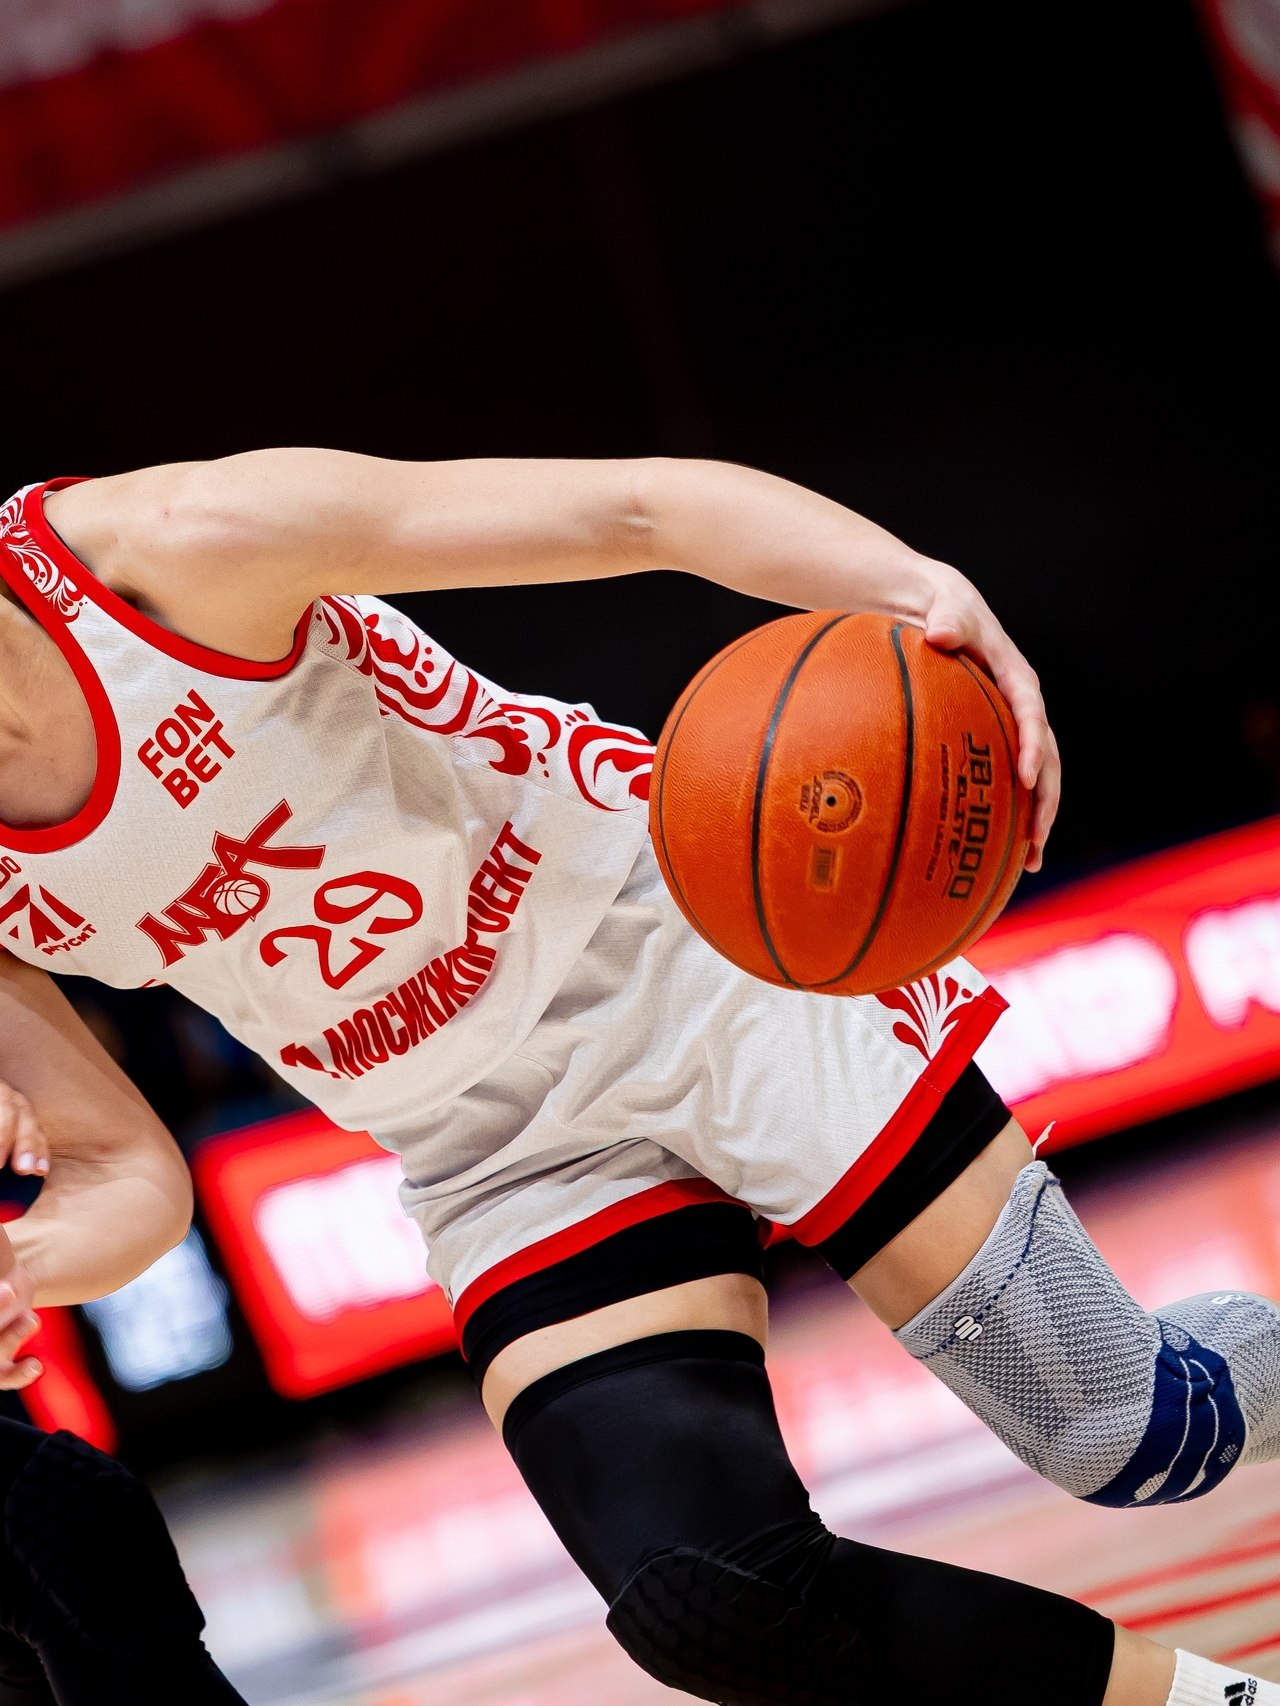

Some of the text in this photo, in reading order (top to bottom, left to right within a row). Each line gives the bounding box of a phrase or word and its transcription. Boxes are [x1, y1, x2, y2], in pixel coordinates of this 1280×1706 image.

[137, 688, 216, 779] FON
[161, 719, 236, 810] BET
[948, 733, 992, 900] JB-1000
[952, 775, 967, 856] ELITE
[259, 870, 424, 990] 29
